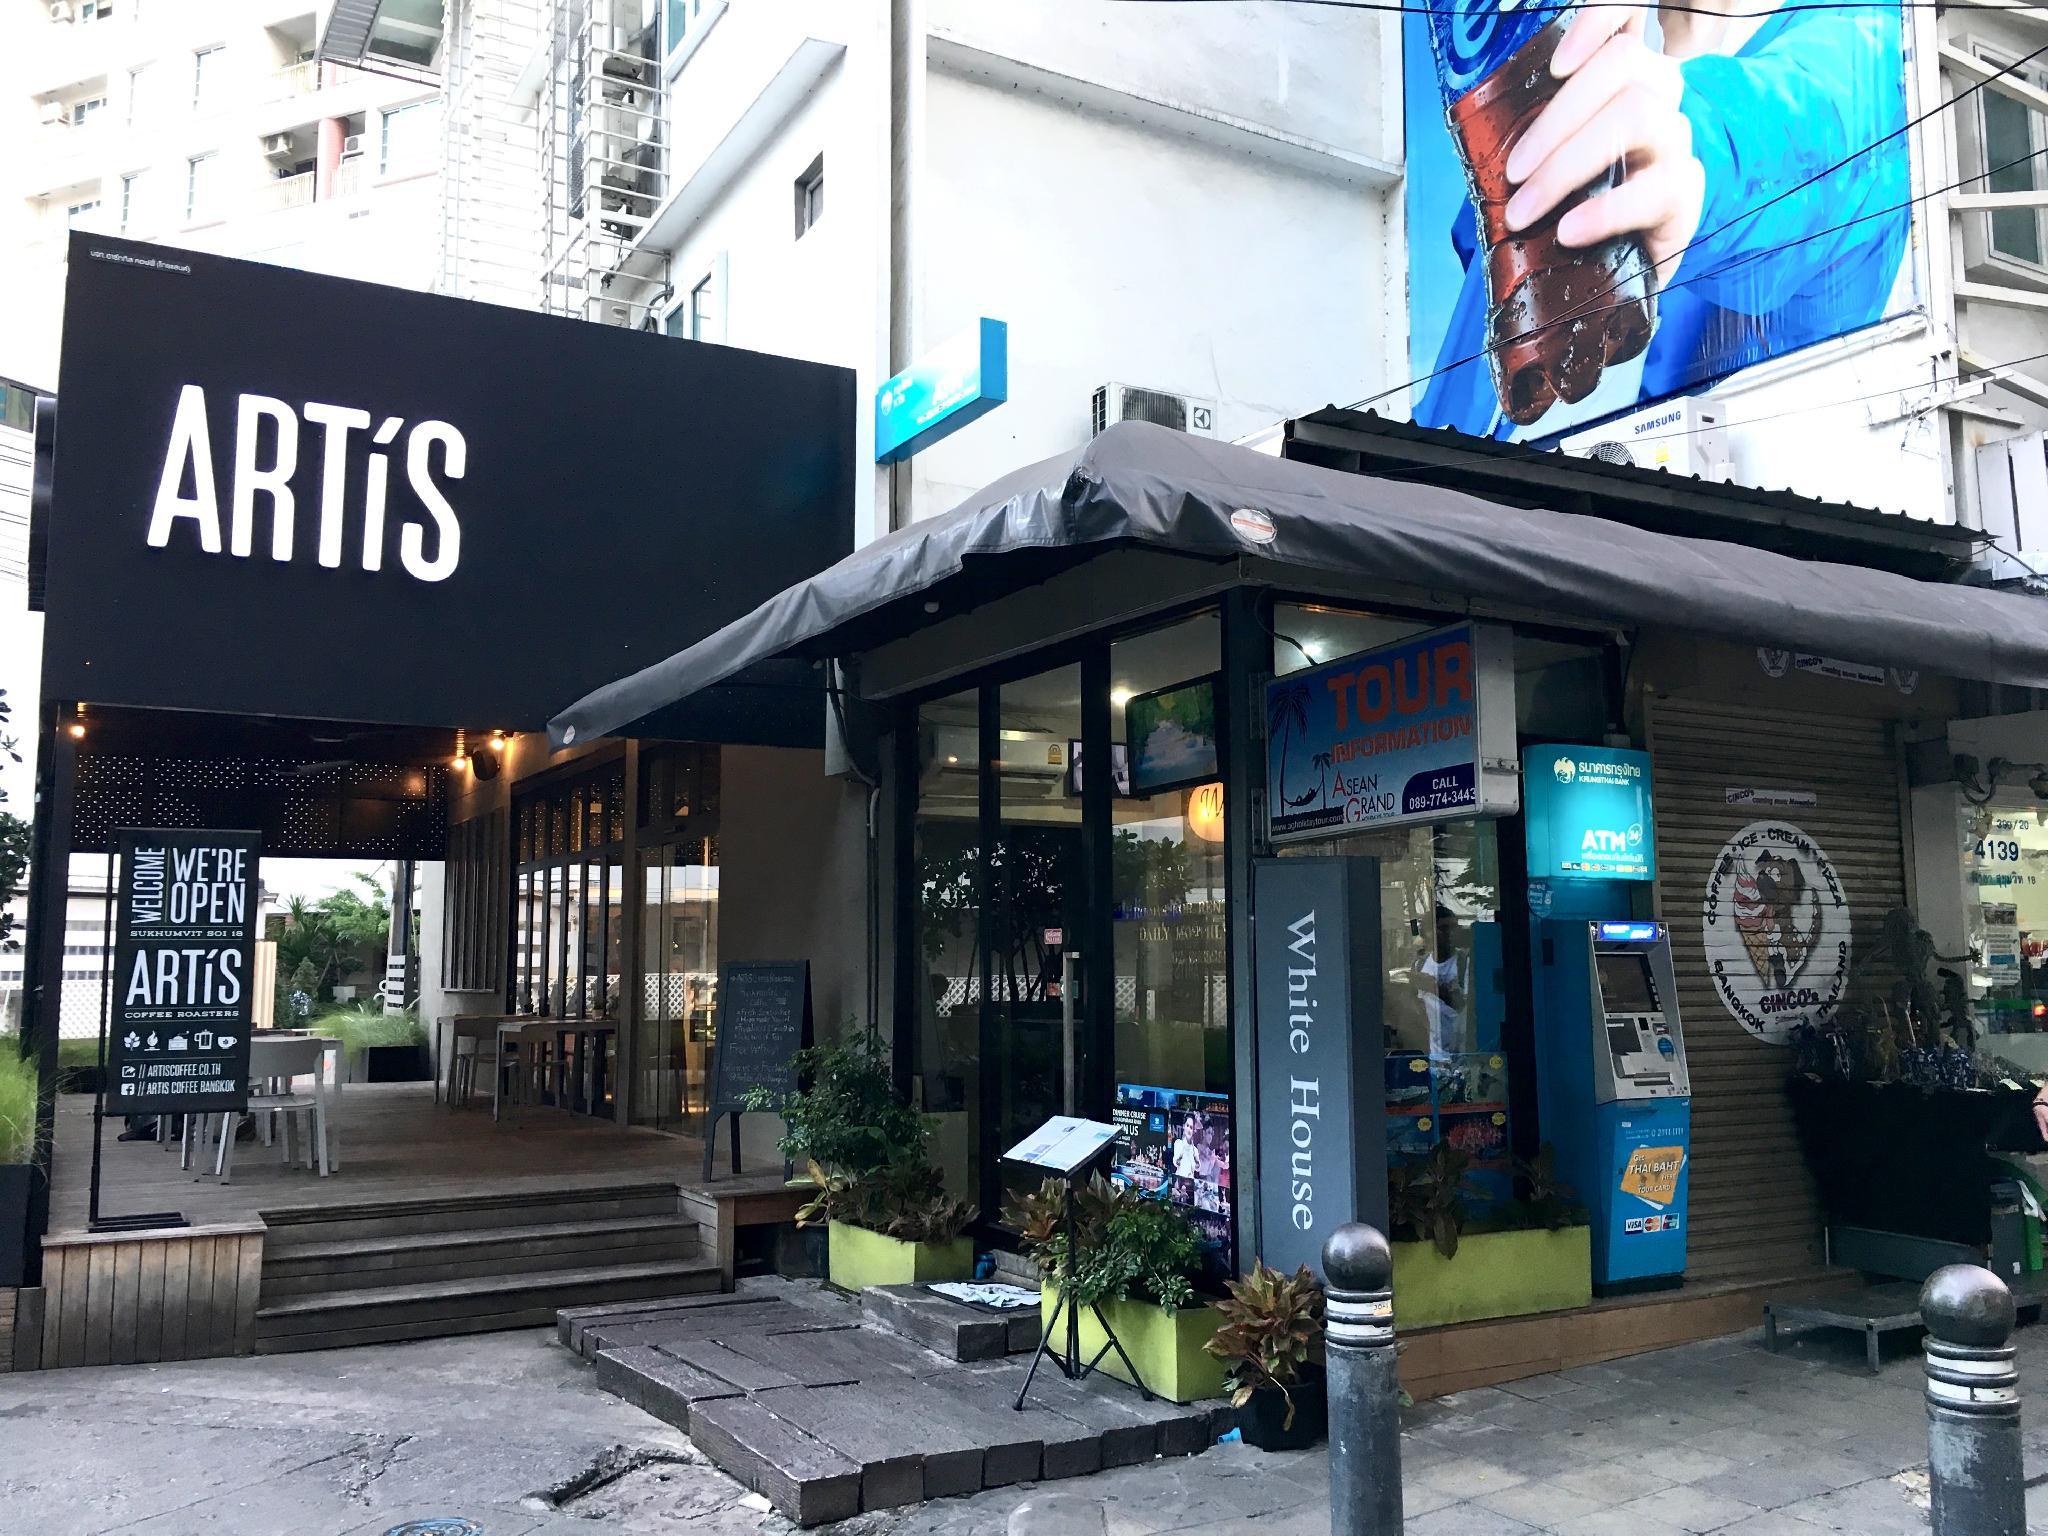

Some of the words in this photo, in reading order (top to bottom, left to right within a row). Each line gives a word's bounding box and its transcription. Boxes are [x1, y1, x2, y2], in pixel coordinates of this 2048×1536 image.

[1635, 411, 1681, 434] SAMSUNG
[1328, 641, 1473, 731] TOUR
[1329, 714, 1471, 764] INFORMATION
[1332, 771, 1378, 798] ASEAN
[1432, 777, 1458, 789] CALL
[1409, 788, 1476, 810] 089-774-3443
[1581, 829, 1626, 852] ATM
[1975, 839, 2019, 861] 4139
[172, 848, 247, 882] WE'RE
[1708, 853, 1733, 925] COFFEE
[1738, 832, 1758, 851] ICE
[1767, 828, 1810, 852] CREAM
[131, 847, 165, 924] WELCOME
[170, 883, 245, 924] OPEN
[130, 930, 203, 938] SUKHUMVIT
[206, 930, 227, 938] SOI
[231, 930, 244, 938] 18
[1287, 909, 1318, 1054] White
[1714, 960, 1765, 1032] BANGKOK
[1759, 988, 1819, 1014] CINCO's
[124, 1011, 173, 1019] COFFEE
[177, 1010, 239, 1018] ROASTERS
[147, 1063, 221, 1077] ARTISCOFFEE.CO.TH
[146, 1081, 169, 1095] ARTIS
[171, 1080, 198, 1094] COFFEE
[200, 1079, 236, 1093] BANGKOK
[1290, 1075, 1320, 1230] House
[1629, 1163, 1651, 1174] THAI
[1653, 1160, 1680, 1172] BAHT
[1627, 1219, 1642, 1230] VISA
